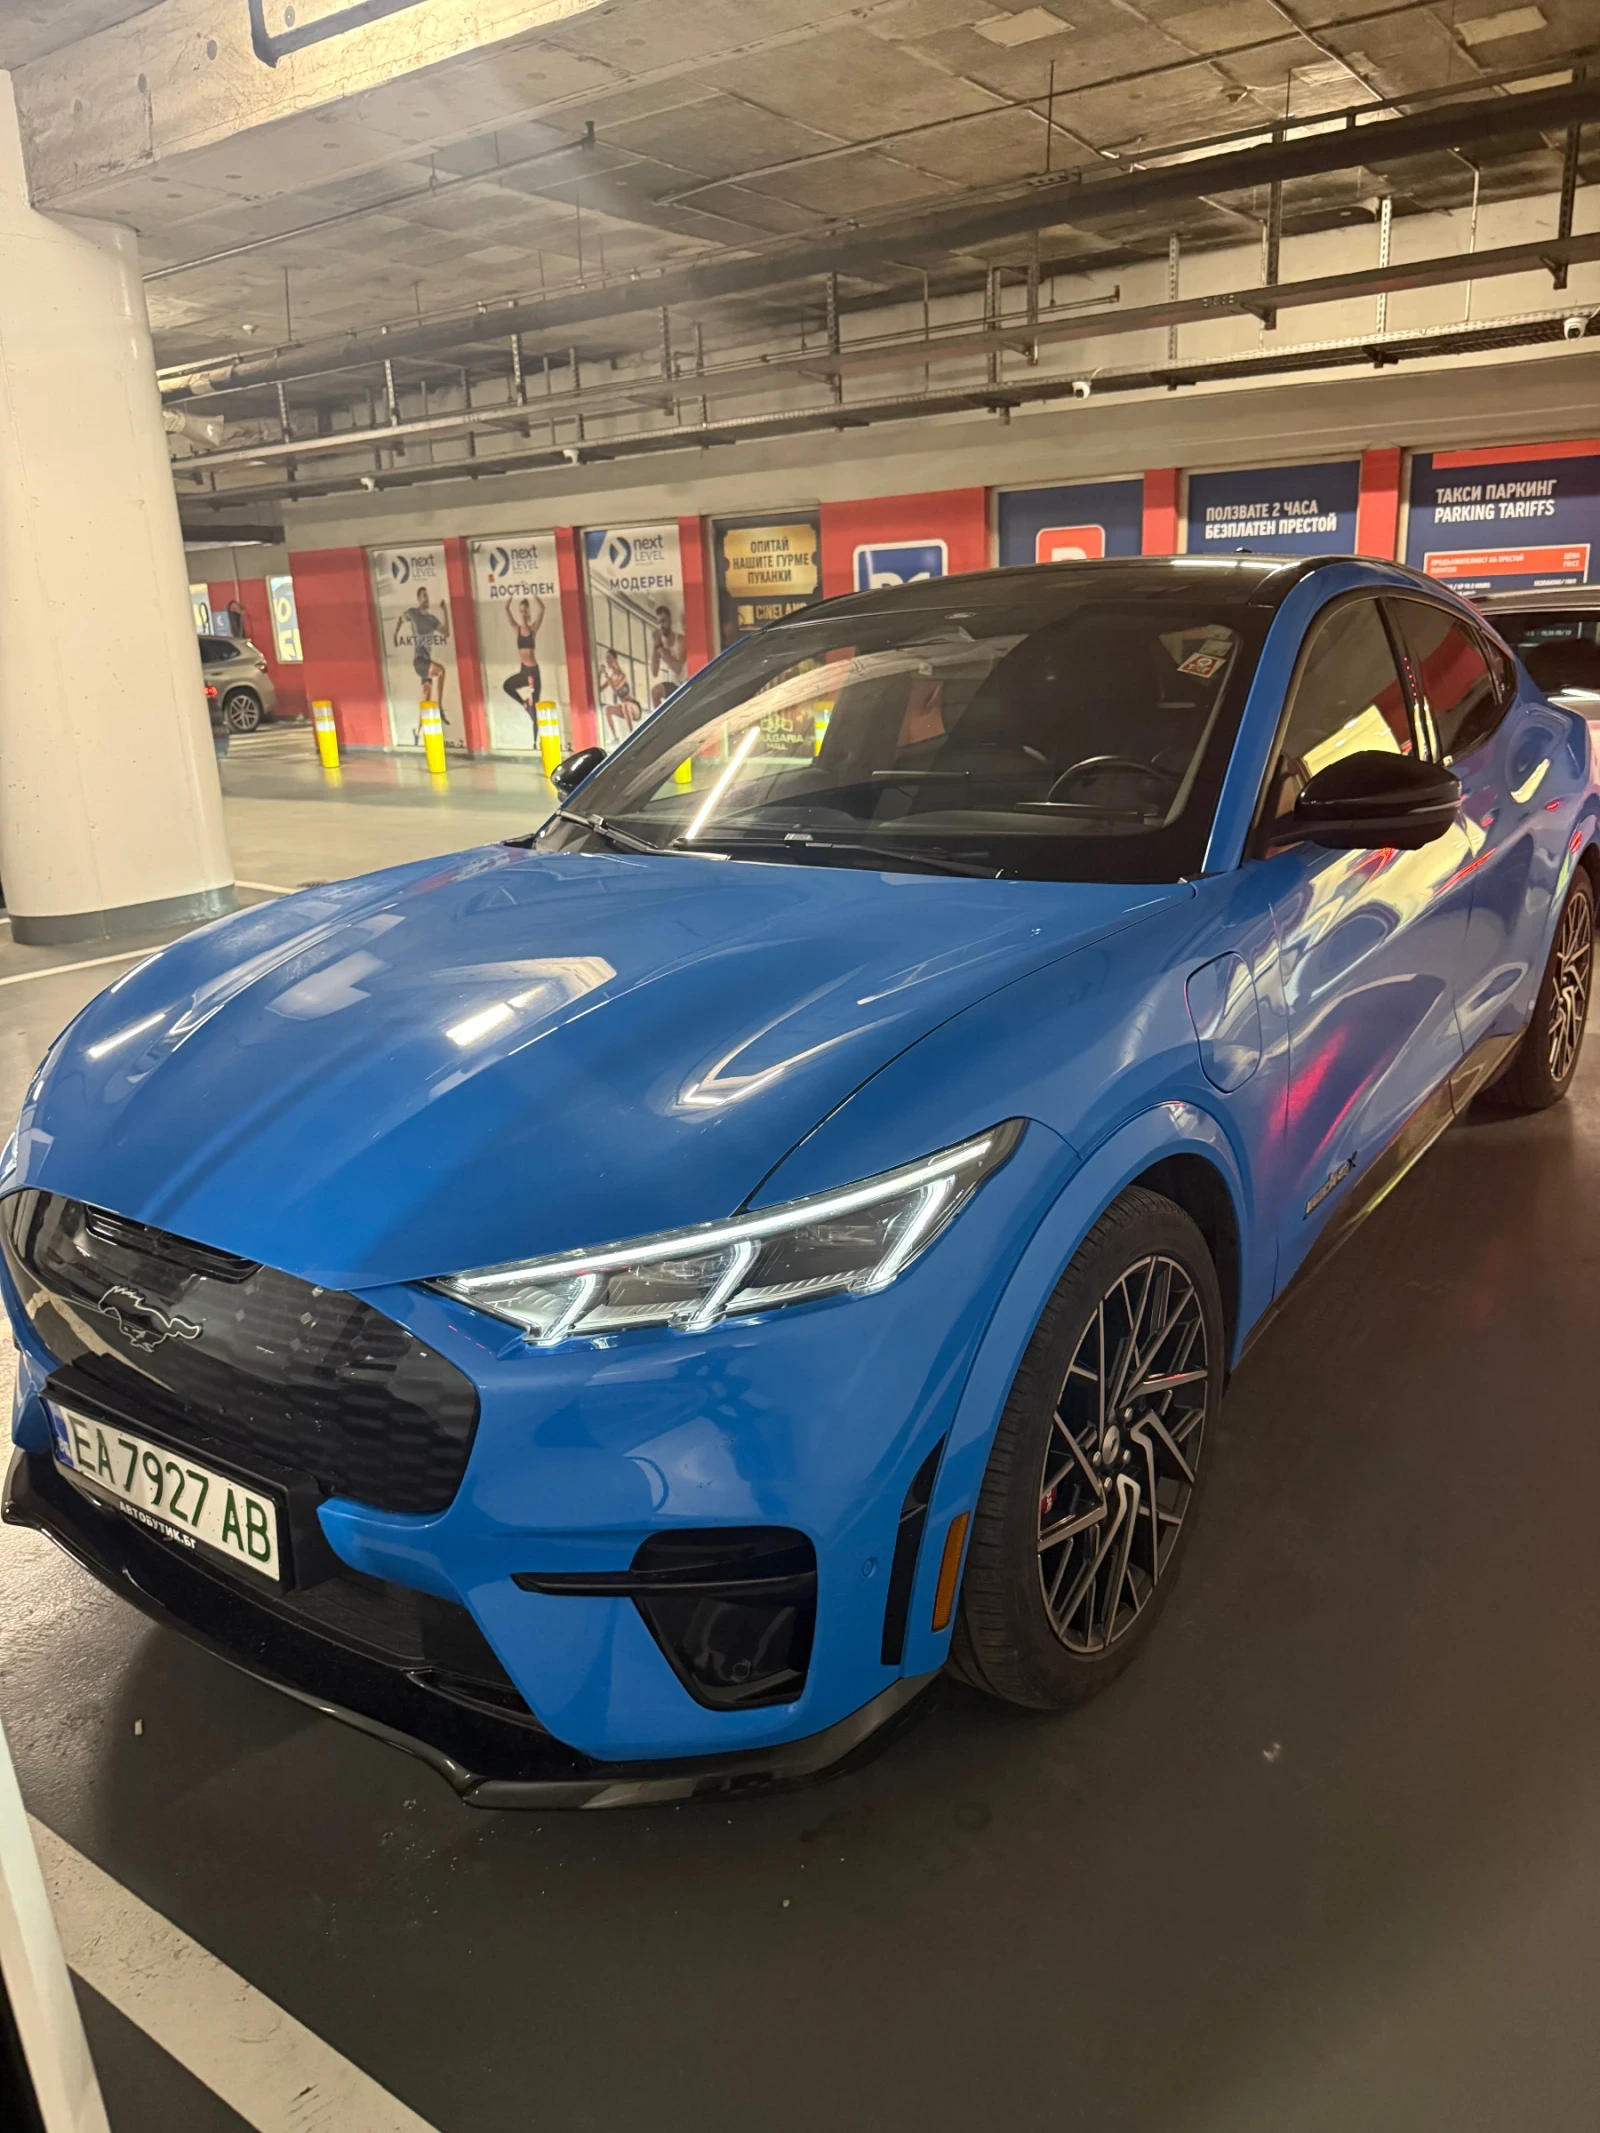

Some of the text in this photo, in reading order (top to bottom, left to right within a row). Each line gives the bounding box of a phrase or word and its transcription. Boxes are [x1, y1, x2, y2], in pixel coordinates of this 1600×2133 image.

[1436, 479, 1557, 504] ТАКСИ ПАРКИНГ
[1206, 499, 1318, 521] ПОЛЗВАТЕ 2 ЧАСА
[1434, 499, 1555, 523] PARKING TARIFFS
[1205, 512, 1337, 539] БЕЗПЛАТЕН ПРЕСТОЙ
[633, 534, 664, 550] next
[750, 536, 789, 553] ОПИТАЙ
[410, 553, 435, 568] next
[511, 545, 538, 560] next
[634, 550, 664, 562] LEVEL
[512, 559, 539, 570] LEVEL
[733, 553, 809, 570] НАШИТЕ ГУРМЕ
[412, 567, 436, 578] LEVEL
[747, 570, 791, 584] ПУКАНКИ
[490, 583, 554, 598] ДОСТЪПЕН
[610, 575, 673, 591] МОДЕРЕН
[399, 635, 448, 647] АКТИВЕН
[67, 1413, 271, 1563] EA 7927 AB
[120, 1501, 197, 1549] АВТОБУТИК.БГ
